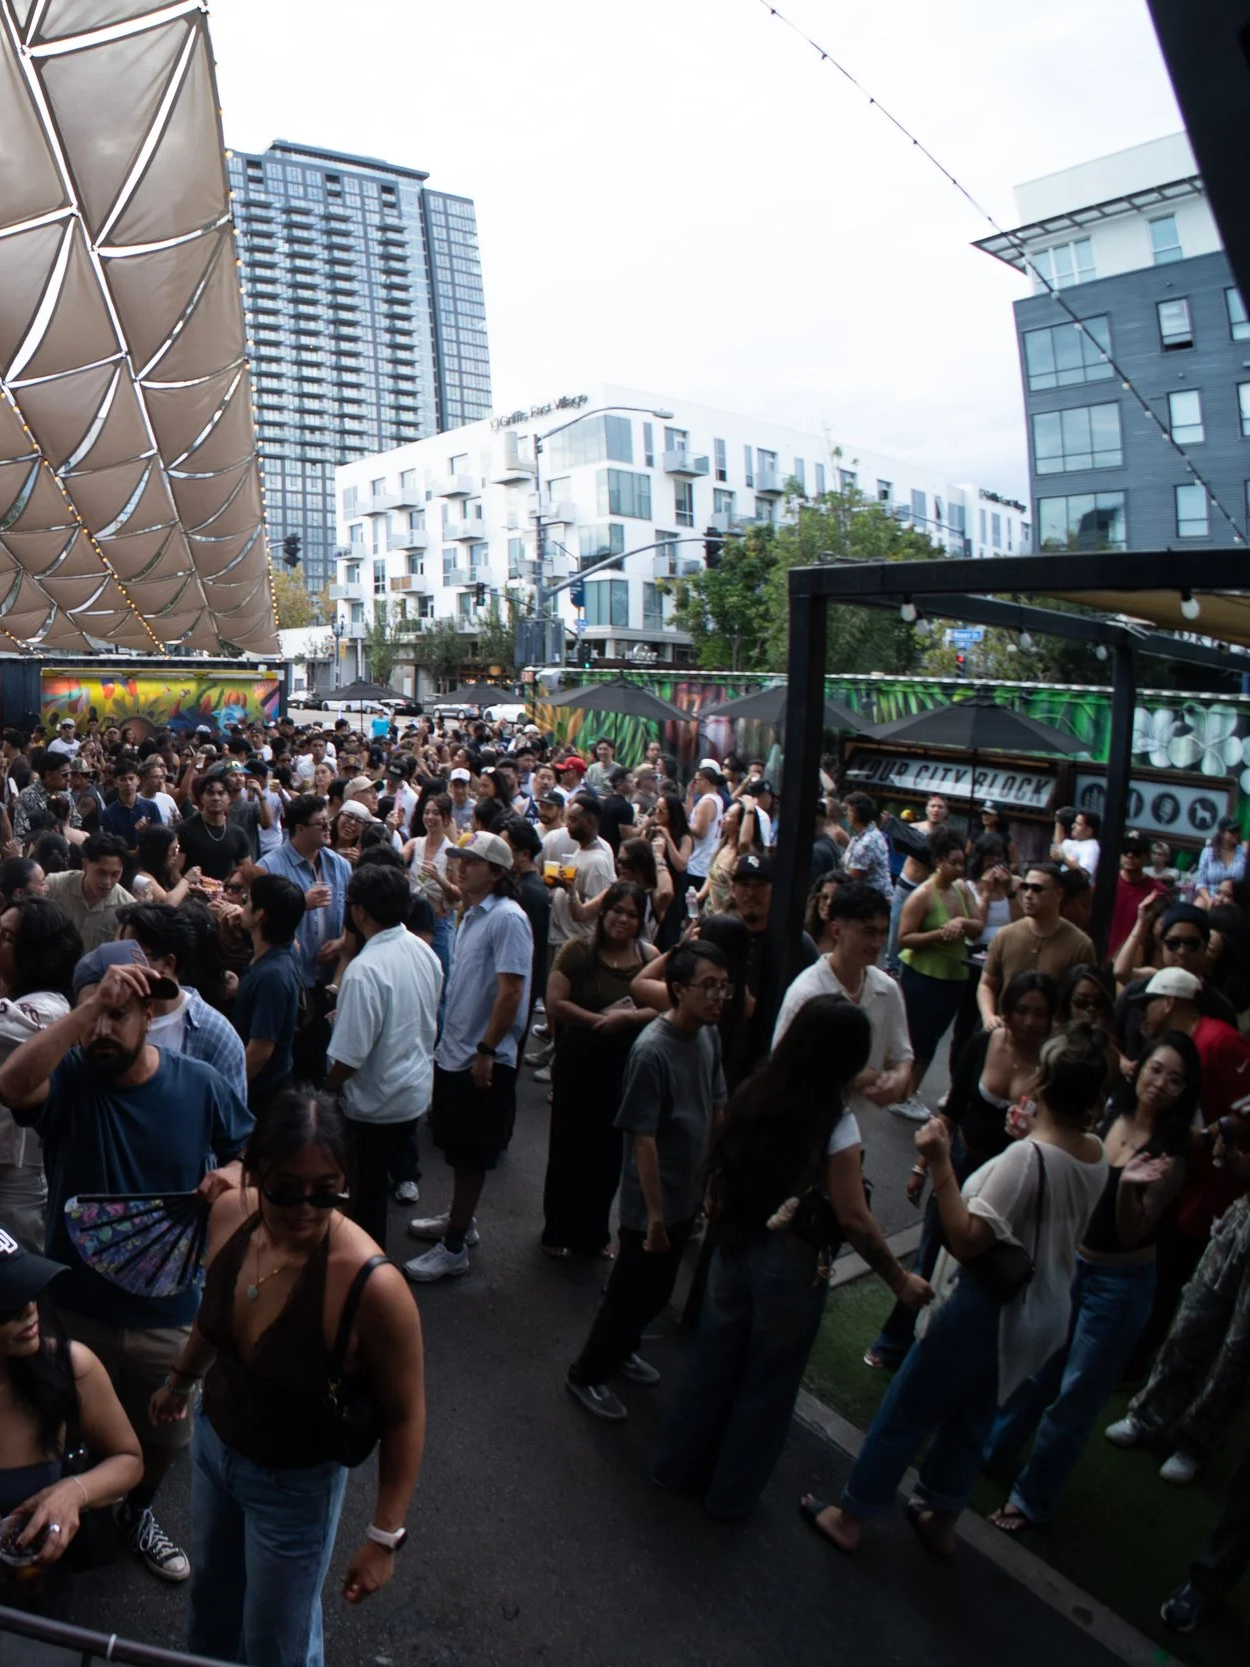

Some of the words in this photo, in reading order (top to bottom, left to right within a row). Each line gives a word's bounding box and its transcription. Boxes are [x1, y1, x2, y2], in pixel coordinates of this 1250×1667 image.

[855, 756, 909, 784] YOUR
[915, 764, 967, 788] CITY
[974, 770, 1050, 802] BLOCK
